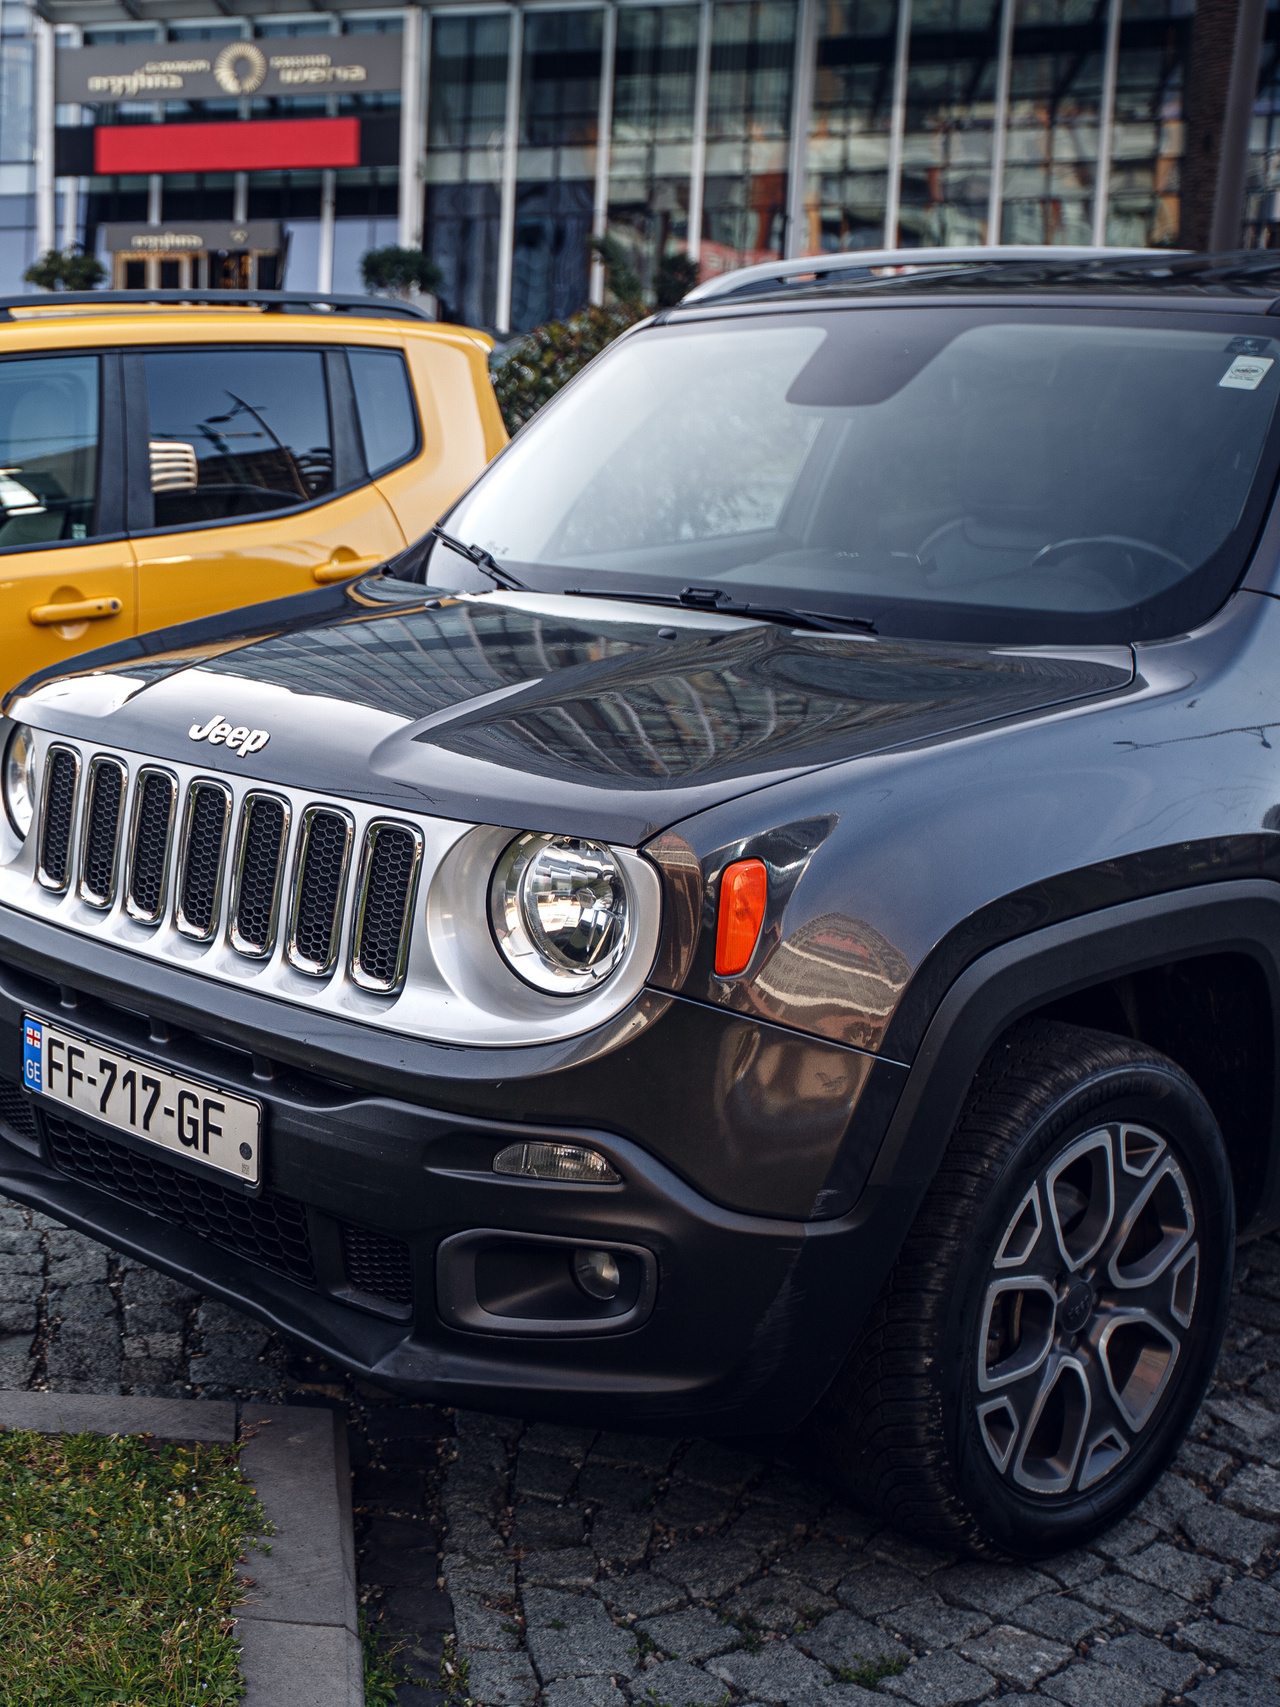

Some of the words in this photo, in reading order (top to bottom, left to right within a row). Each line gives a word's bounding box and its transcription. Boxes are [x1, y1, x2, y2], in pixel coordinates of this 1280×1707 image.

[188, 715, 271, 758] Jeep
[25, 1059, 41, 1084] GE
[48, 1037, 226, 1156] FF-717-GF
